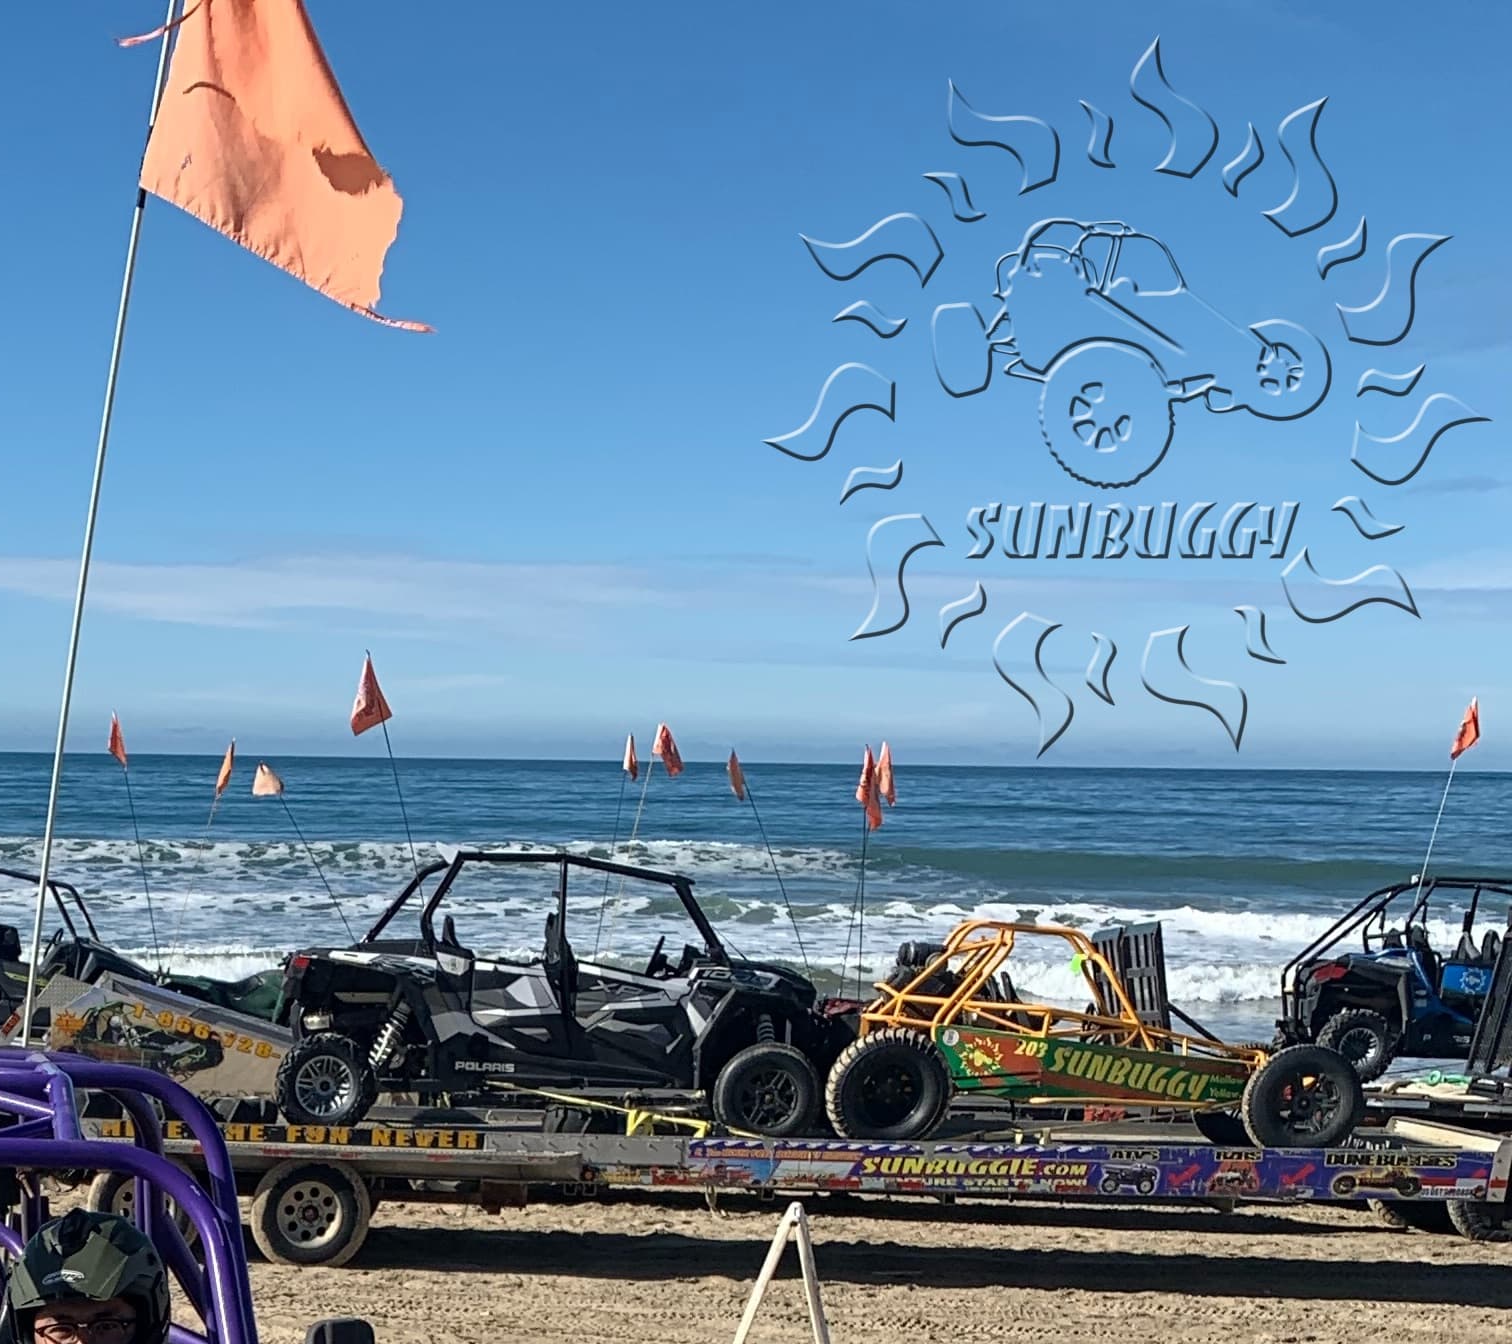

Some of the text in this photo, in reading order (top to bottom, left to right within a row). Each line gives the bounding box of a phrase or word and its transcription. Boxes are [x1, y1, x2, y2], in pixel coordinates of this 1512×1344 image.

[1014, 1039, 1049, 1059] 203
[454, 1060, 515, 1074] POLARIS
[1048, 1047, 1210, 1100] SUNBUGGY
[371, 1128, 478, 1149] NEVER
